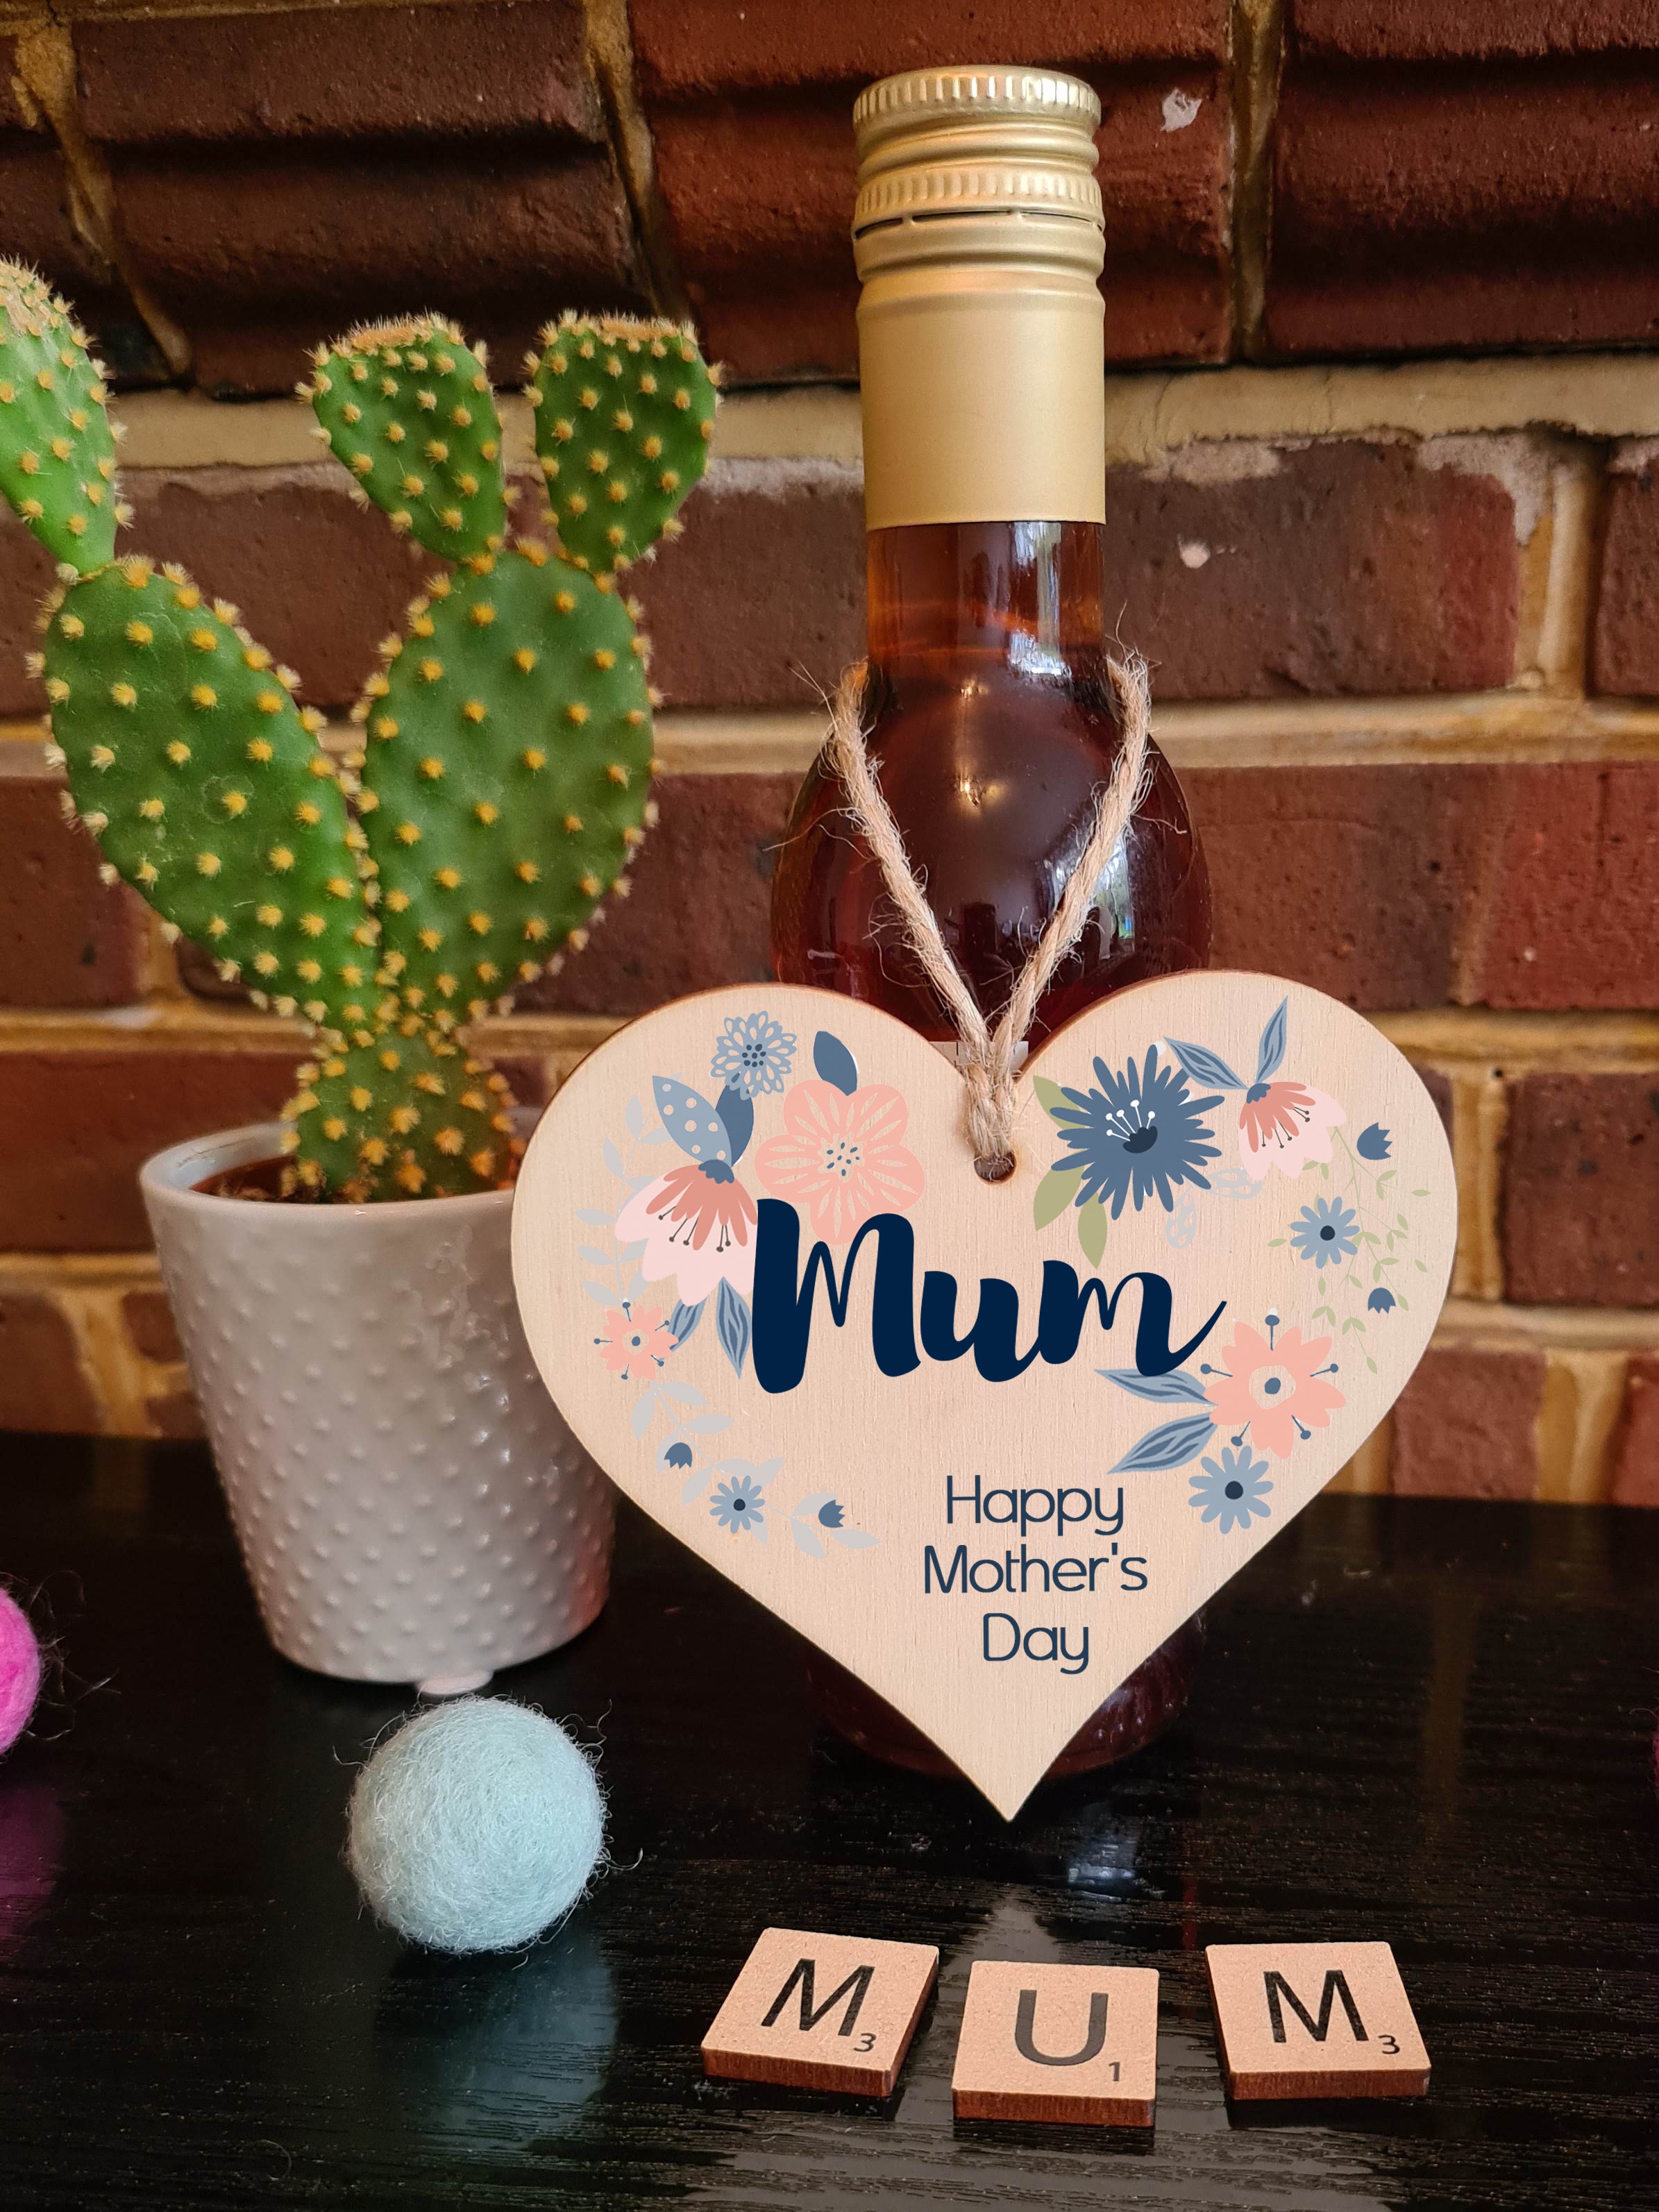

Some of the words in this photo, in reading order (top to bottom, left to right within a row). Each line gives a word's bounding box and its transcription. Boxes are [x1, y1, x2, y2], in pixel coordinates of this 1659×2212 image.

[751, 1199, 1227, 1394] Mum
[946, 1474, 1124, 1536] Happy
[924, 1542, 1148, 1594] Mother's
[982, 1612, 1090, 1675] Day
